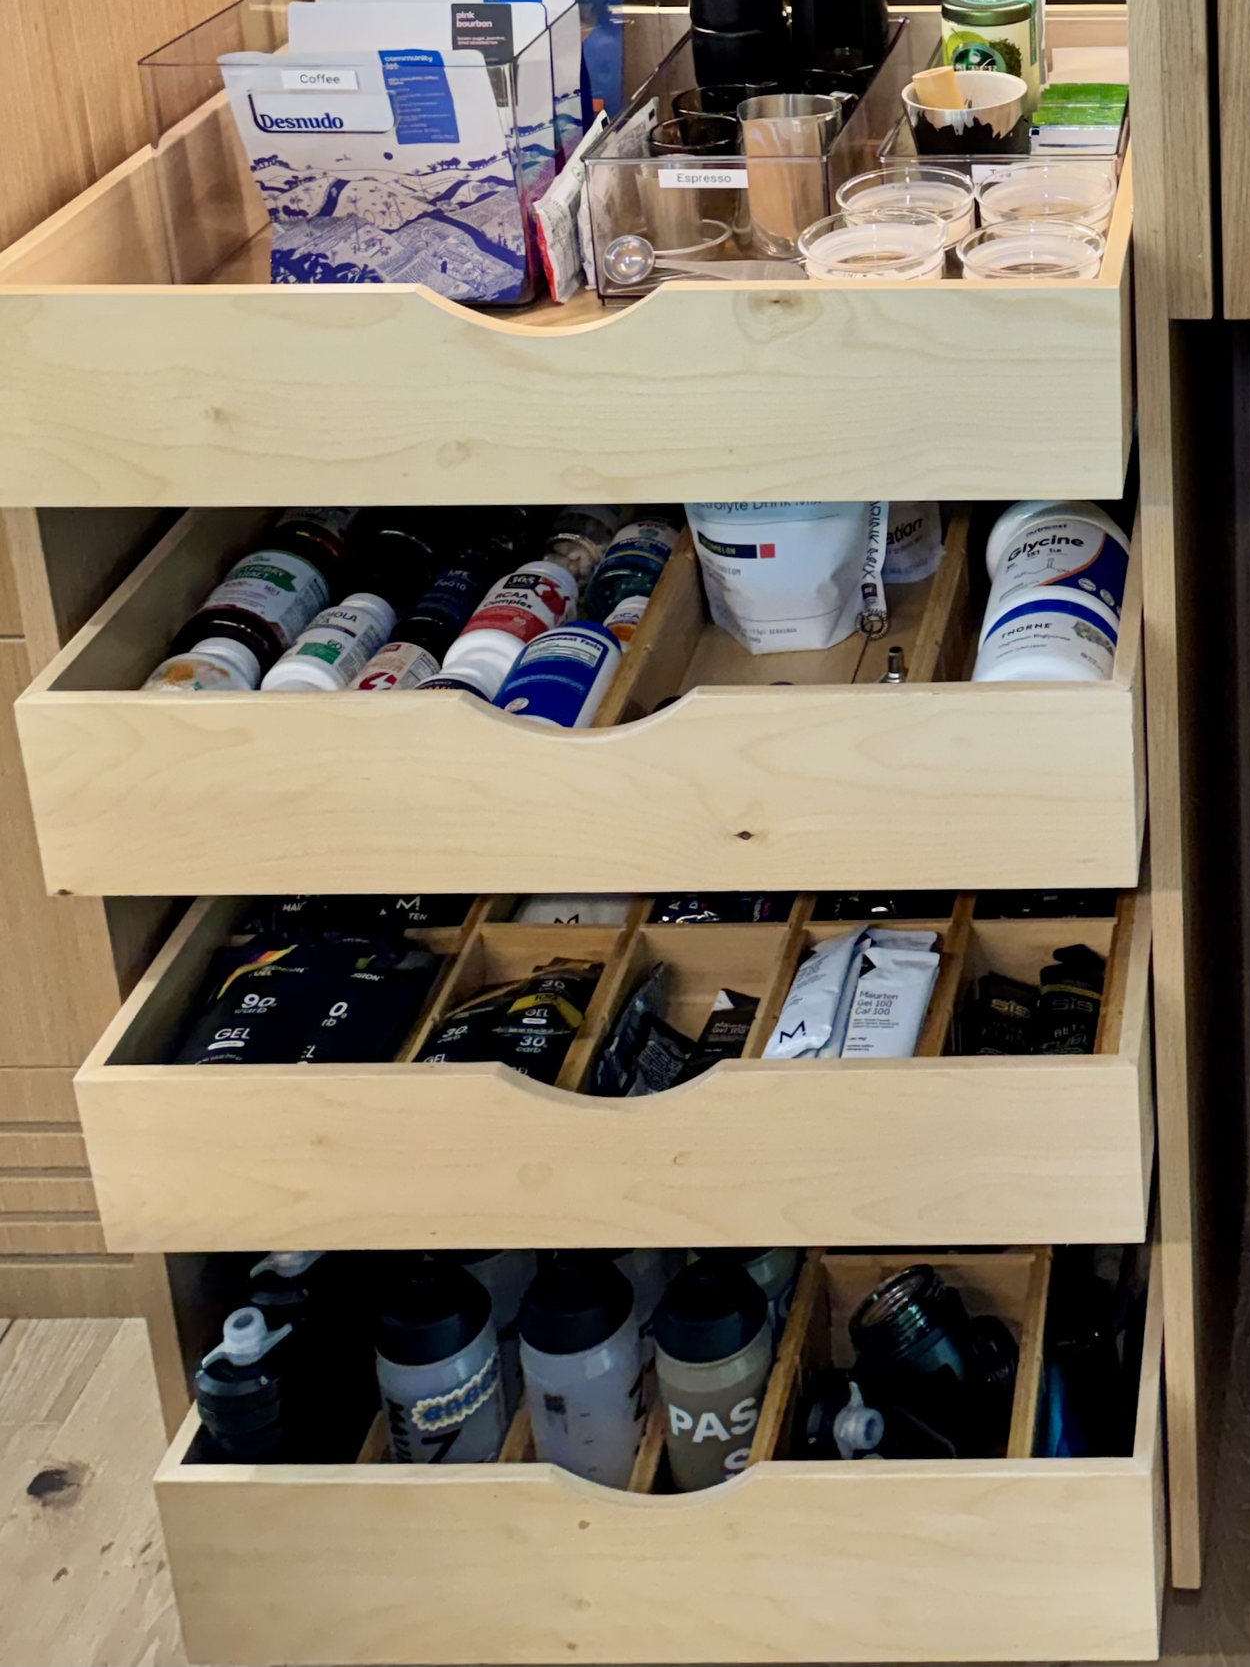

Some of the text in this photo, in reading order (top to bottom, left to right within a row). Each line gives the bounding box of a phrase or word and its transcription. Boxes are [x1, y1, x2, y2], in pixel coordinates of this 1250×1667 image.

[455, 11, 475, 21] pink
[456, 20, 493, 29] bourbon
[300, 73, 341, 85] Coffee
[261, 113, 344, 130] Desnudo
[676, 172, 732, 186] Espresso
[1007, 534, 1085, 563] Glycine
[508, 574, 538, 586] 365
[494, 590, 529, 601] BCAA
[483, 597, 533, 611] Complex
[1000, 622, 1051, 640] THORNE
[580, 636, 604, 653] Facts
[859, 990, 899, 1001] Maurten
[856, 999, 893, 1008] Gel 100
[524, 1008, 550, 1018] GEL
[854, 1007, 891, 1016] Caf 100
[214, 1026, 251, 1040] GEL
